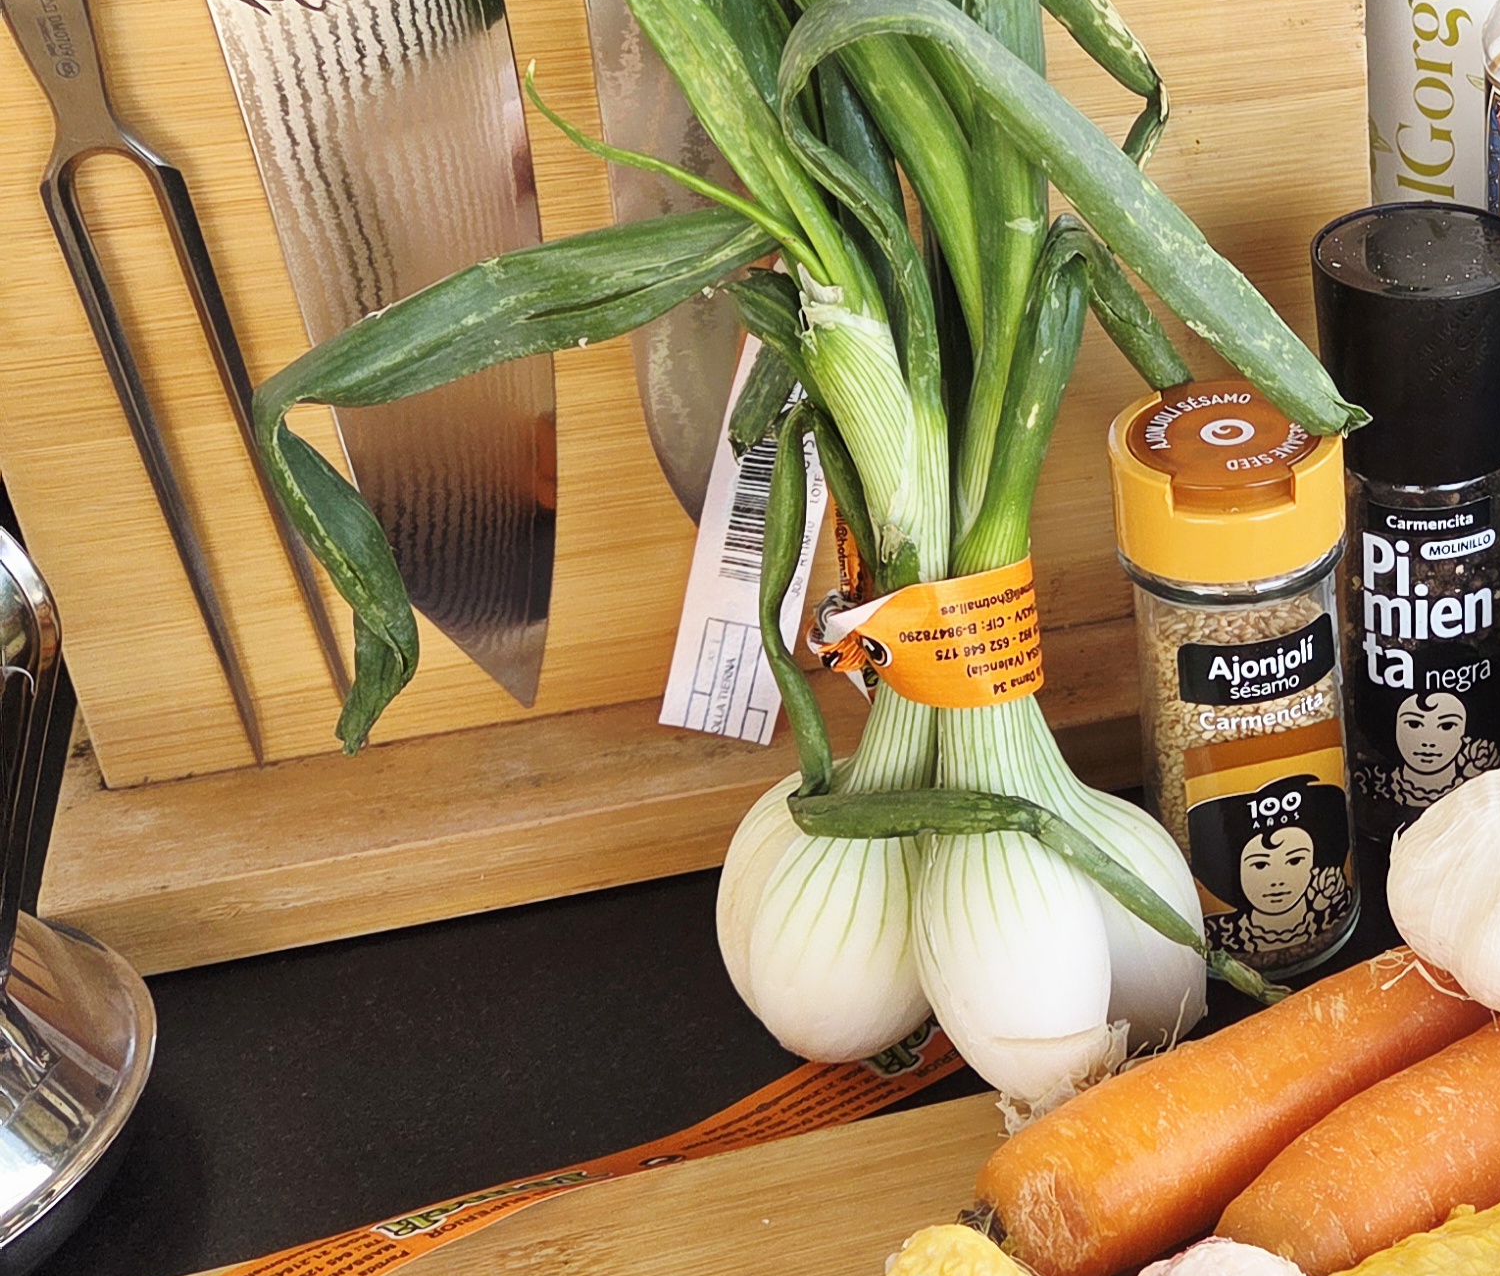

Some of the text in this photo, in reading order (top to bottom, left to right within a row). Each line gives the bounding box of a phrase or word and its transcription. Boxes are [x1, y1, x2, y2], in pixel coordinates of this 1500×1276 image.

[1176, 393, 1251, 413] SÉSAMO
[1226, 454, 1274, 471] SEED
[1385, 513, 1474, 531] Carmencita
[1428, 533, 1491, 557] MOLINILLO
[1362, 531, 1410, 597] Pi
[1363, 583, 1493, 640] mien
[980, 616, 1005, 632] CIF:
[935, 648, 959, 662] 175
[990, 638, 1010, 652] 652
[966, 652, 1025, 679] (Valencia)
[1208, 634, 1315, 686] Ajonjolí
[1362, 632, 1491, 693] ta negra
[992, 680, 1008, 696] 34
[1230, 674, 1300, 700] sésamo
[1199, 692, 1324, 732] Carmencita
[1247, 791, 1303, 819] 100
[1252, 812, 1300, 830] AÑOS
